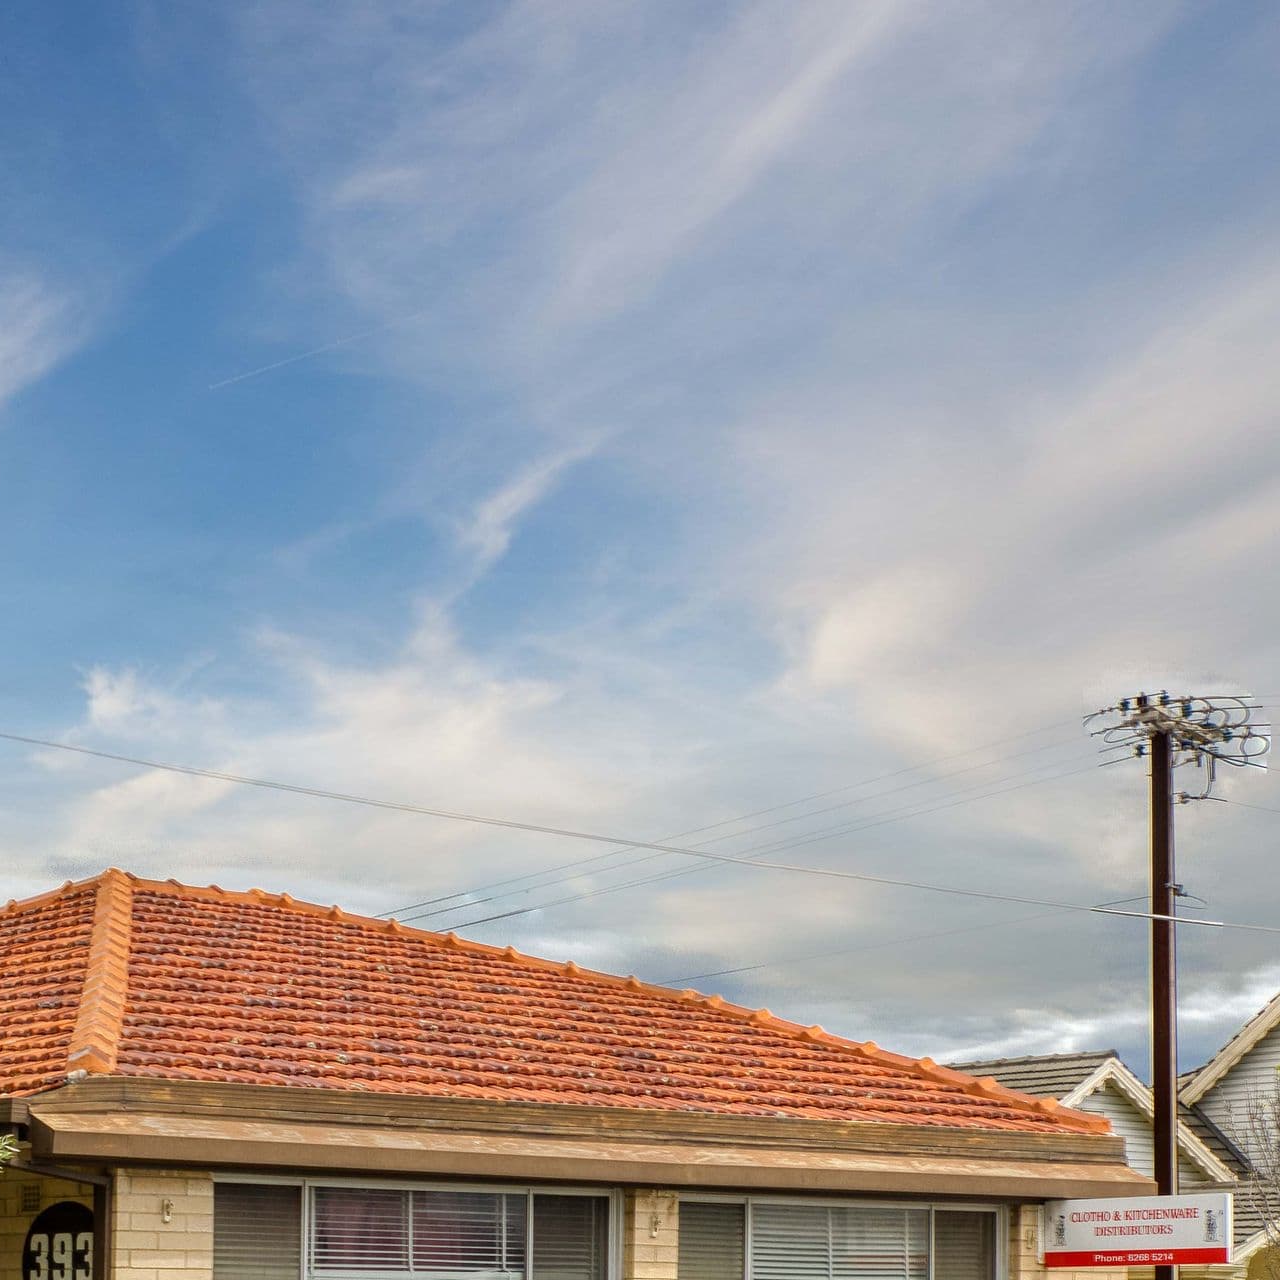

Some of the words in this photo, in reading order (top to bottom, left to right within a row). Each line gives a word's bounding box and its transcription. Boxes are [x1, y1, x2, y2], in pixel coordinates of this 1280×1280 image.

[1071, 1211, 1111, 1223] CLOTHO
[1113, 1210, 1121, 1222] &
[1125, 1208, 1200, 1221] KITCHENWARE
[1095, 1224, 1174, 1237] DISTRIBUTORS
[1094, 1254, 1126, 1263] Phone:
[1151, 1252, 1174, 1261] 5214
